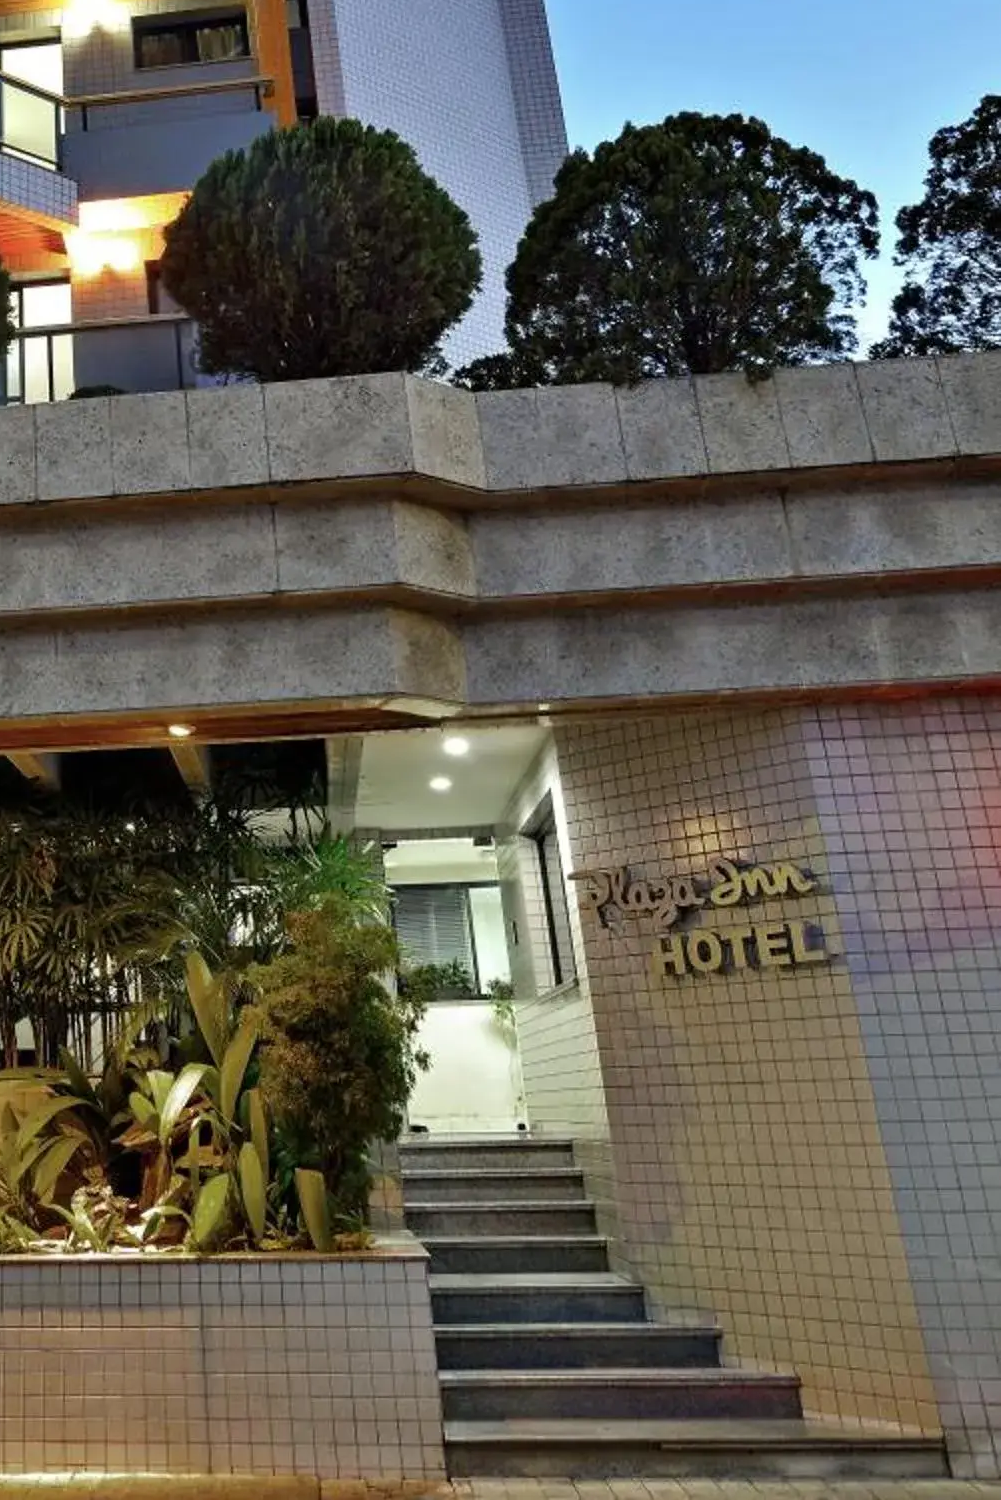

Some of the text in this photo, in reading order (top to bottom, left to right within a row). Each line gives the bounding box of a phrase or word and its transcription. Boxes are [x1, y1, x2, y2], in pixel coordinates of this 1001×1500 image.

[567, 857, 813, 936] Plaza Inn
[652, 921, 830, 976] HOTEL
